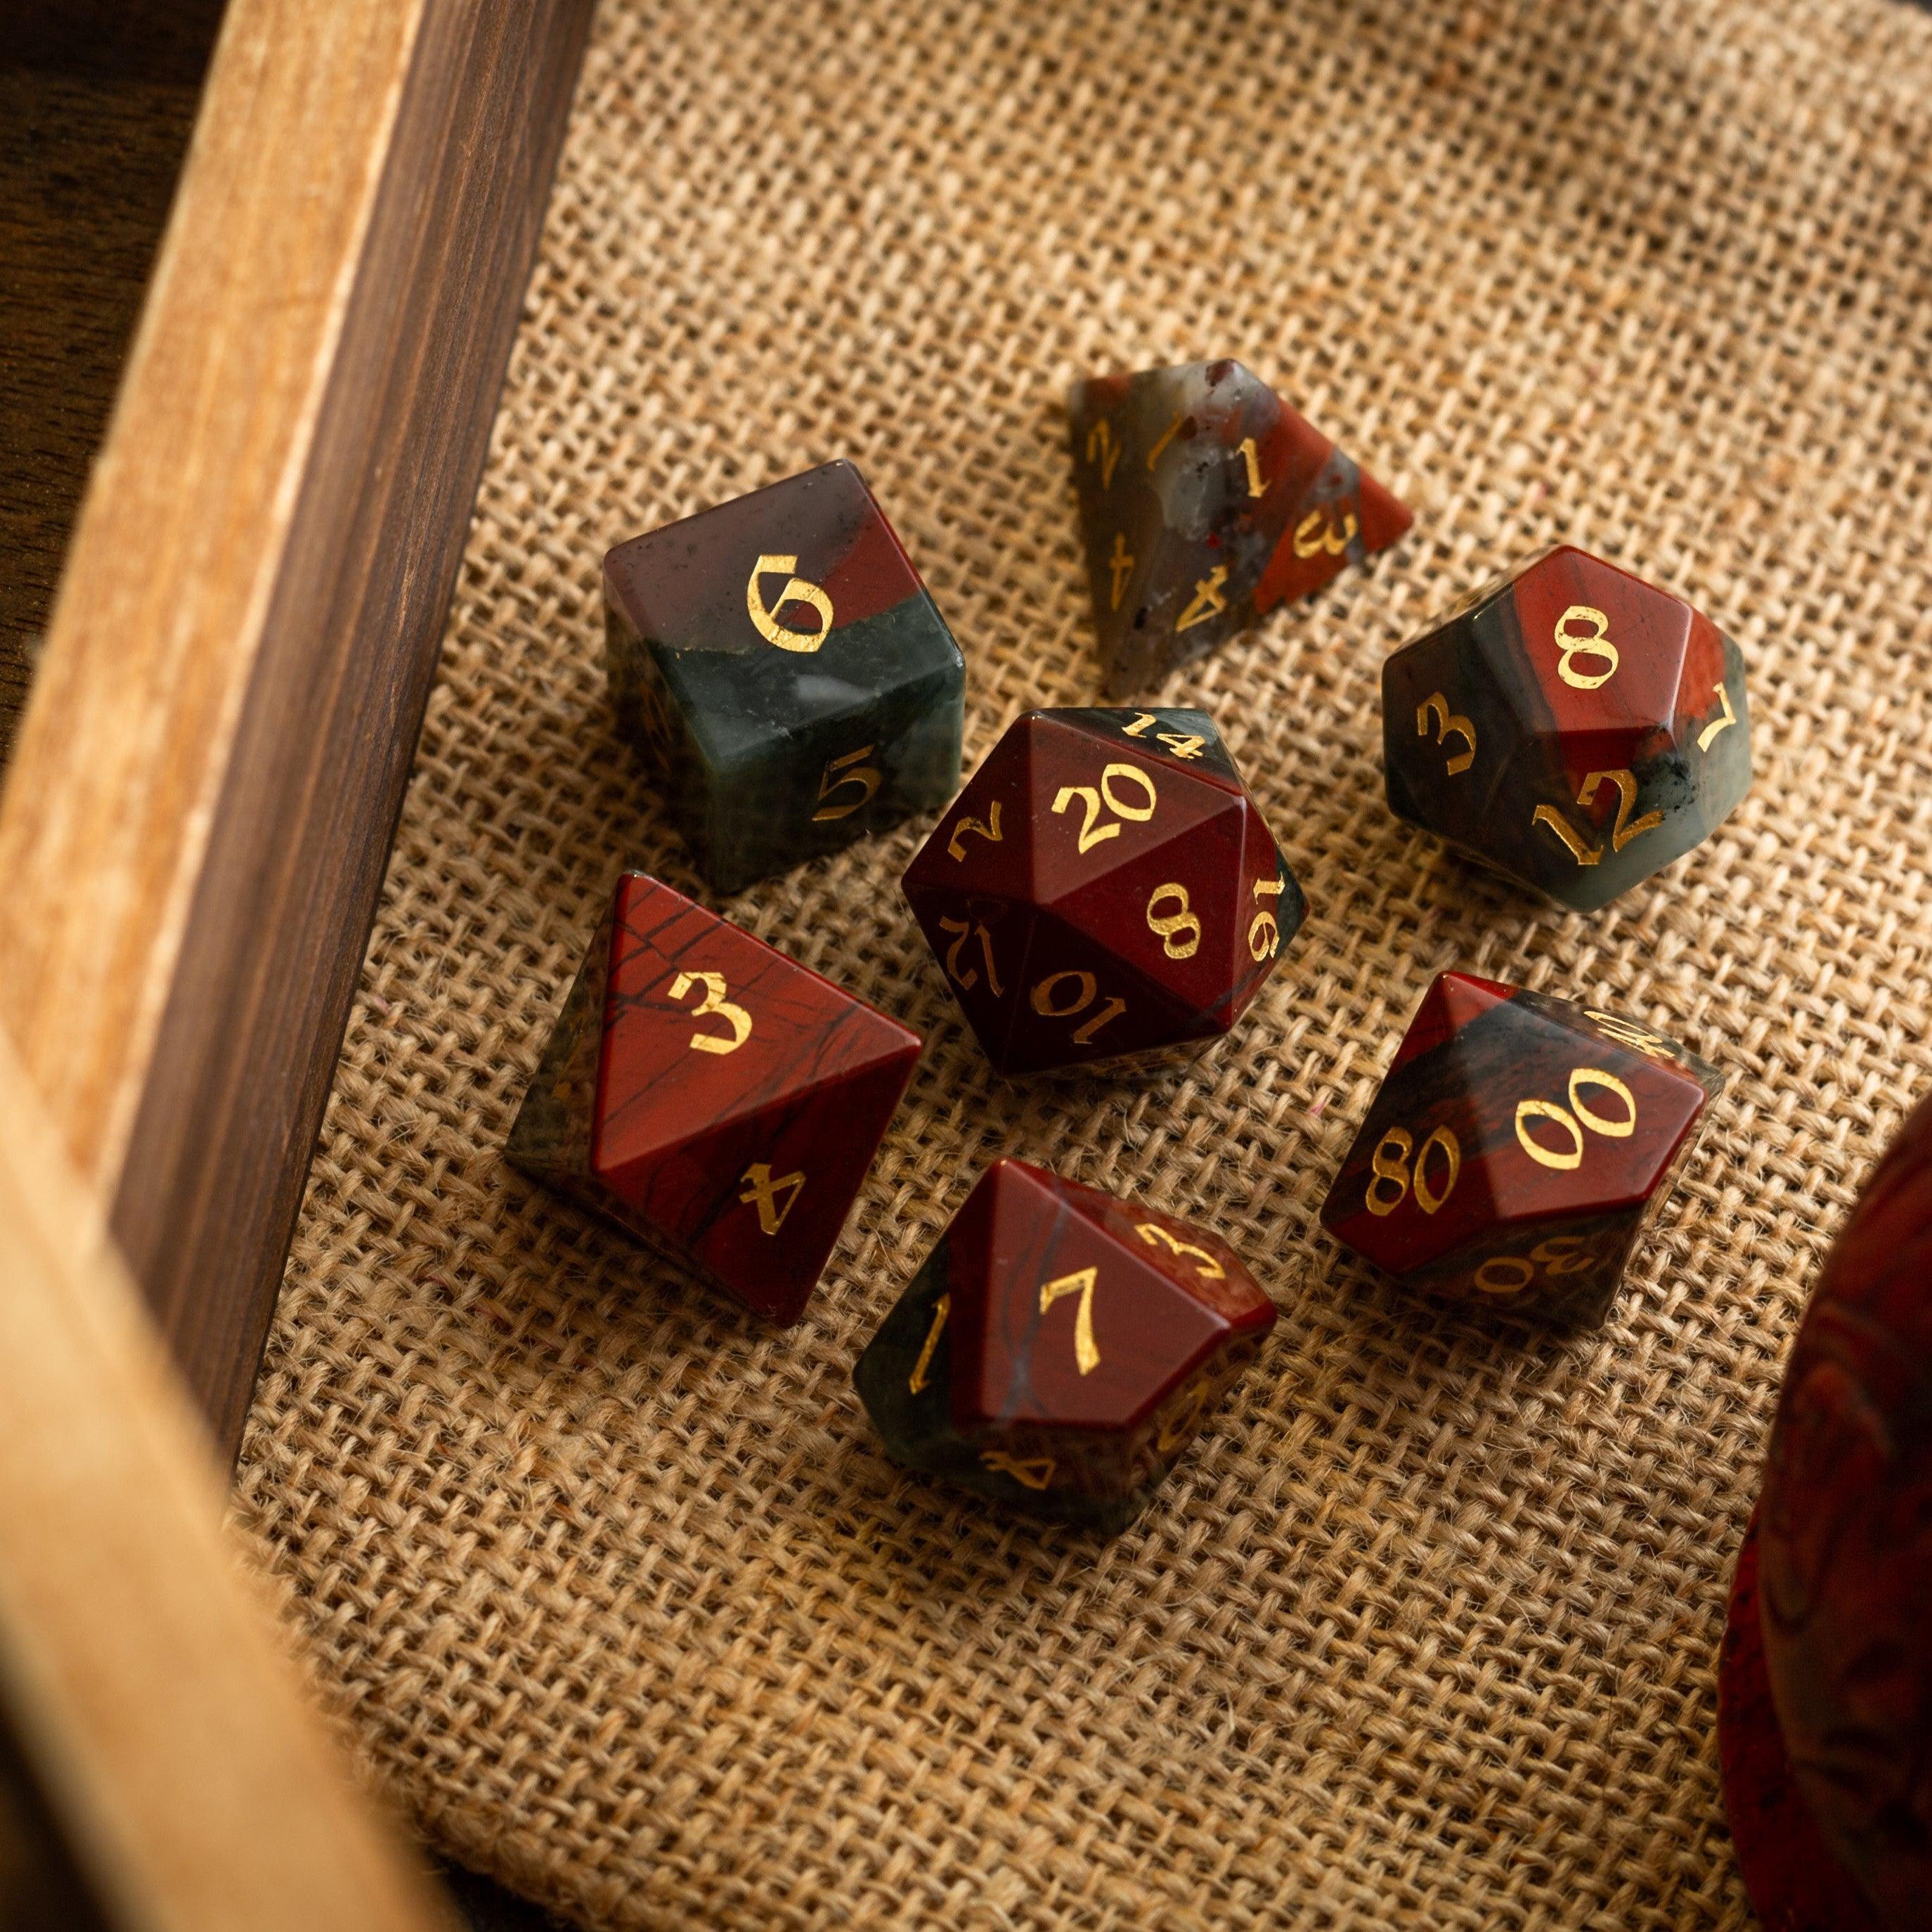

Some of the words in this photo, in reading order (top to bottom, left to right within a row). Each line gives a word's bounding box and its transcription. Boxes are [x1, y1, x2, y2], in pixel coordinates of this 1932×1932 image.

[1238, 438, 1271, 498] 1
[1293, 510, 1357, 559] 3
[747, 555, 834, 652] 6
[1176, 565, 1227, 633] 4
[1554, 605, 1619, 689] 8
[1121, 712, 1207, 759] 14
[1416, 691, 1476, 775] 3
[1697, 682, 1736, 753] 7
[811, 744, 883, 822] 5
[1051, 763, 1157, 855] 20
[1531, 769, 1665, 865] 12
[947, 800, 1003, 862] 2
[1147, 883, 1200, 959] 8
[1247, 874, 1285, 961] 16
[939, 916, 1005, 998] 12
[667, 971, 753, 1055] 3
[1030, 971, 1127, 1044] 10
[1515, 1068, 1637, 1170] 00
[740, 1162, 807, 1236] 4
[1366, 1124, 1460, 1217] 80
[1134, 1222, 1226, 1279] 3
[1474, 1236, 1595, 1293] 30
[909, 1293, 950, 1395] 1
[1039, 1267, 1101, 1377] 7
[979, 1451, 1056, 1490] 4
